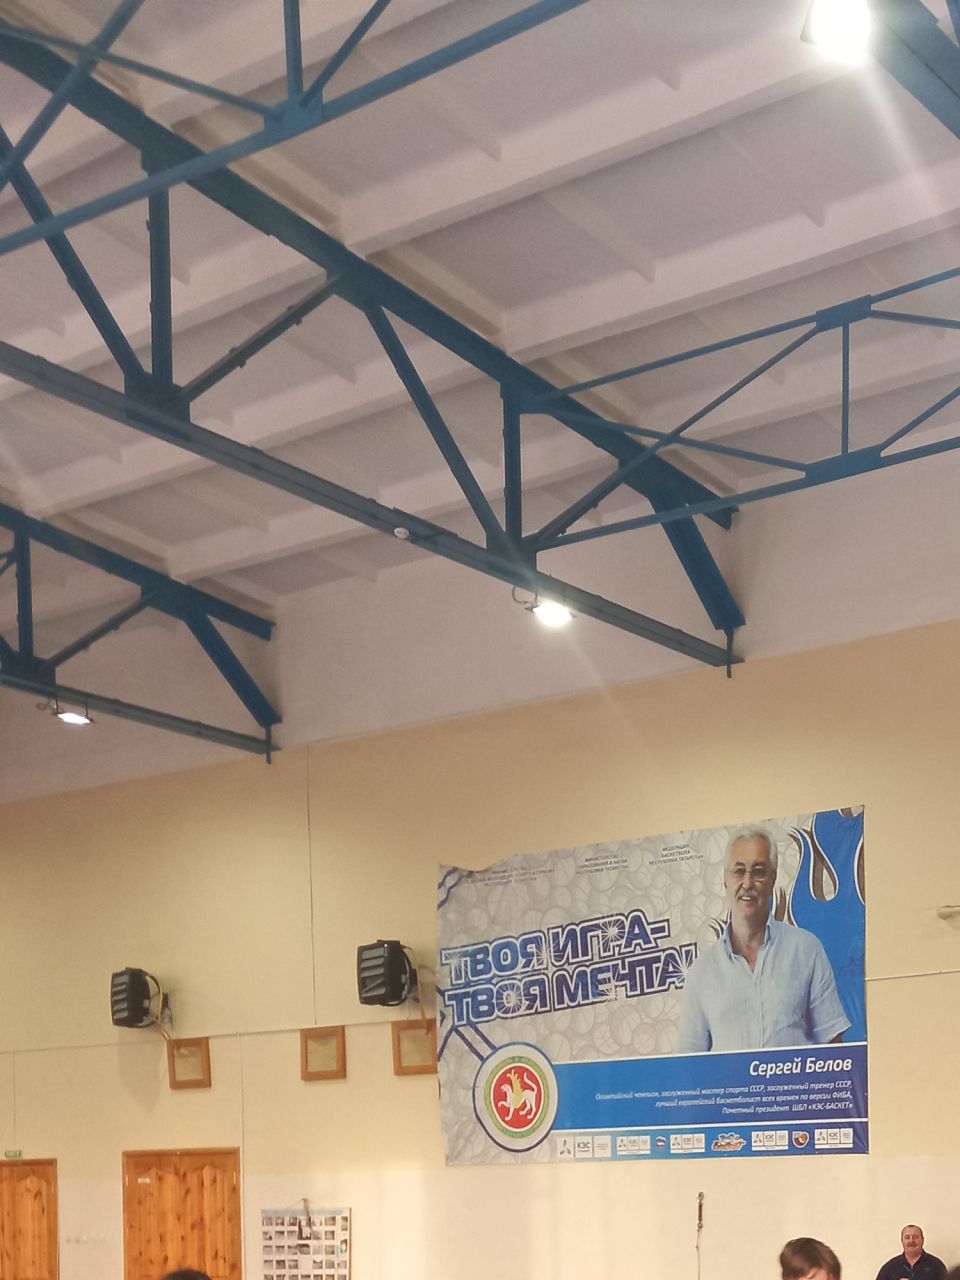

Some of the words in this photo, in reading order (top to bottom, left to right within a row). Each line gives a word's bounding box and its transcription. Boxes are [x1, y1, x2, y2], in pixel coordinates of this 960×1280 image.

[440, 931, 548, 985] ТВОЯ
[443, 973, 551, 1026] ТВОЯ
[749, 1057, 801, 1078] Сергей
[805, 1058, 852, 1073] Белов
[835, 1080, 852, 1088] СССР,
